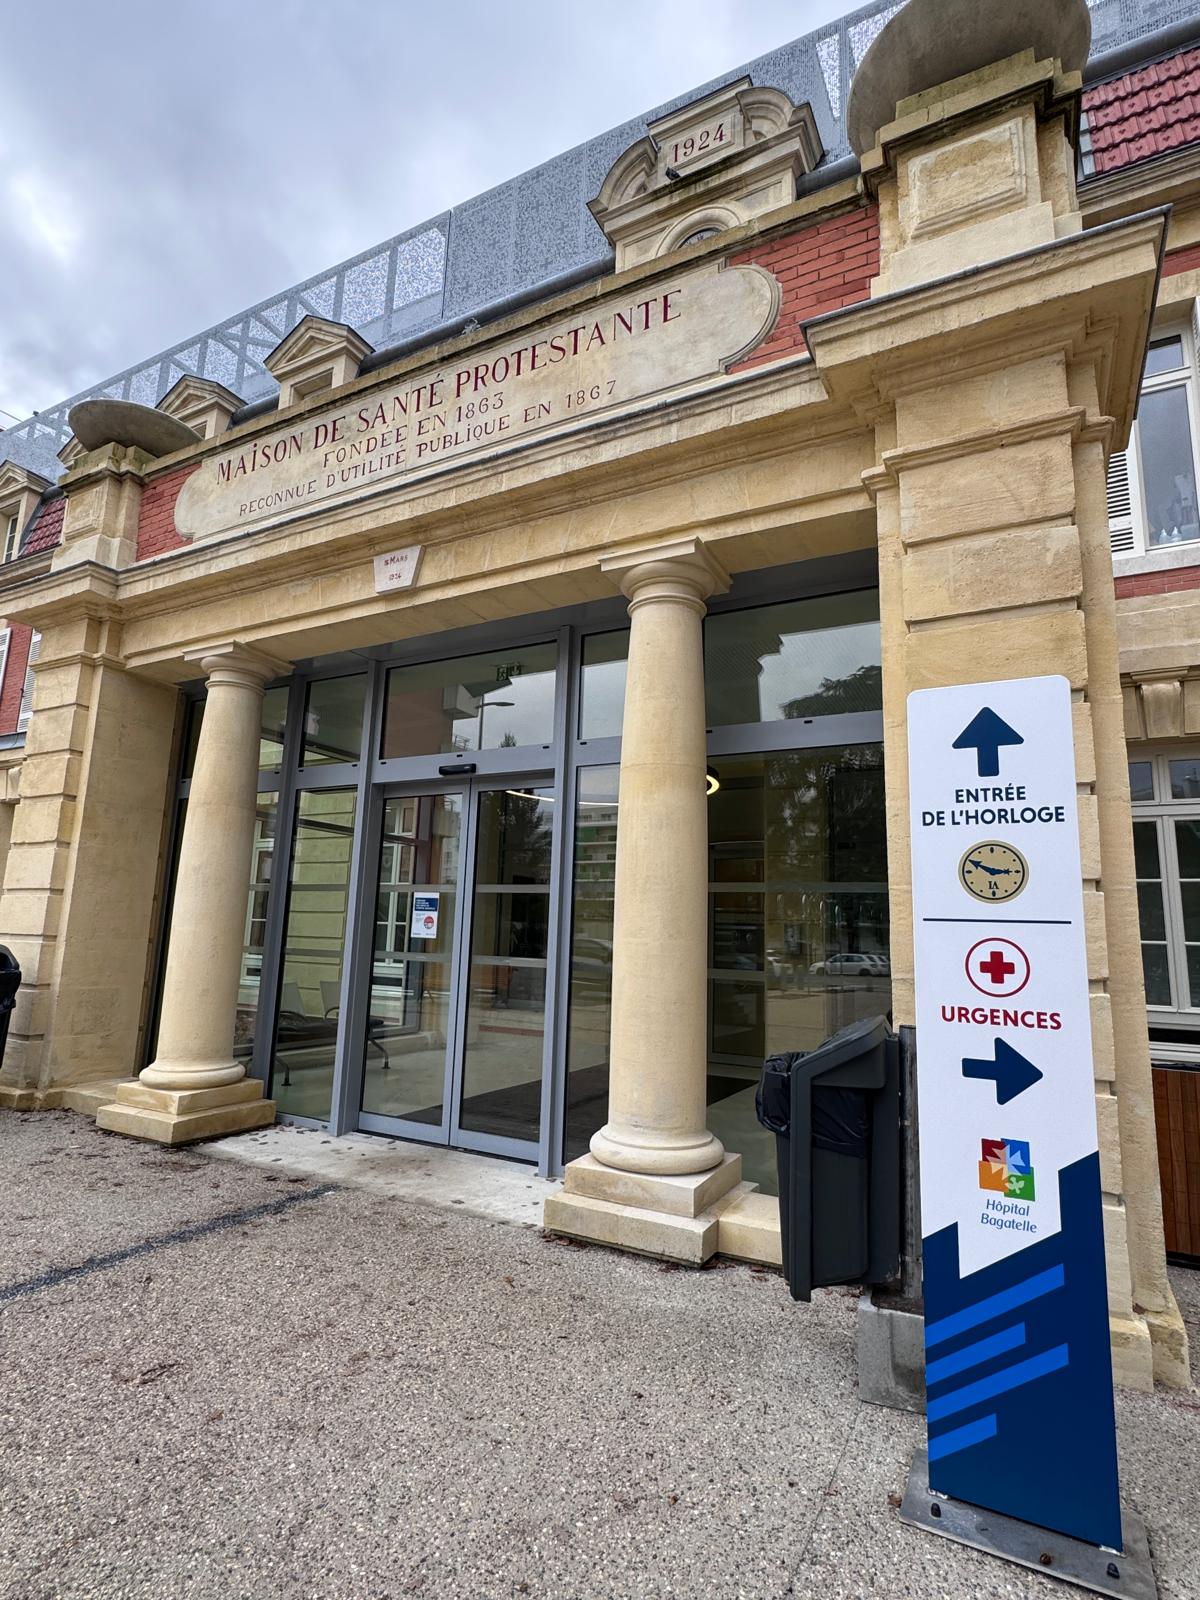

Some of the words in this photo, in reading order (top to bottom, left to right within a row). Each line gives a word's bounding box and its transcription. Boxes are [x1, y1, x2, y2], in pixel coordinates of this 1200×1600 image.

[672, 122, 726, 163] 1924
[313, 416, 346, 450] DE
[357, 373, 444, 433] SANTÉ
[455, 289, 682, 399] PROTESTANTE
[323, 423, 408, 468] FONDÉE
[417, 410, 447, 436] EN
[456, 391, 504, 423] 1863
[239, 480, 317, 517] RECONNUE
[524, 401, 552, 423] EN
[565, 380, 617, 408] 1867
[955, 783, 1027, 803] ENTRÉE
[922, 811, 946, 826] DE
[951, 806, 1066, 826] L'HORLOGE
[941, 1005, 1063, 1030] URGENCES
[986, 1199, 1030, 1217] Hôpital
[981, 1213, 1038, 1233] Bagatelle
